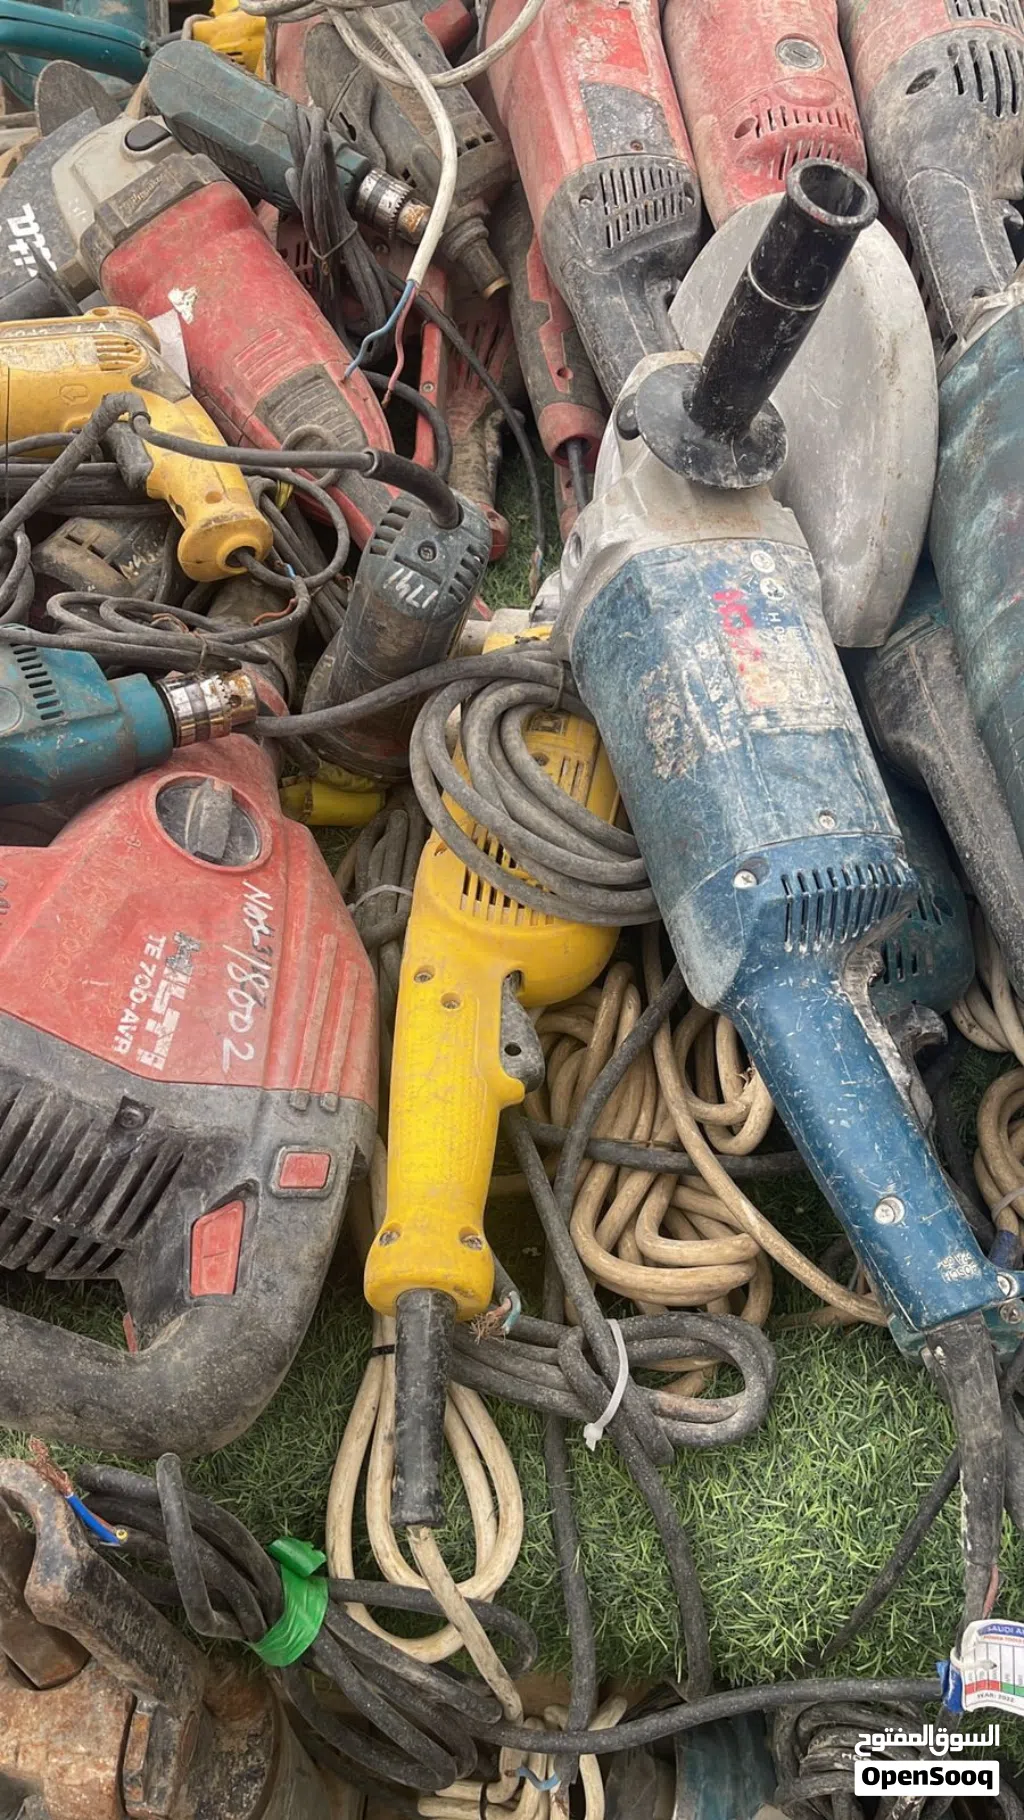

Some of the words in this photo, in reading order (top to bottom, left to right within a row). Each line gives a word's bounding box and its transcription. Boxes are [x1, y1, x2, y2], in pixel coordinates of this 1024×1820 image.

[144, 935, 167, 960] TE
[111, 961, 157, 1055] 700-AVR
[136, 931, 201, 1071] HILTI
